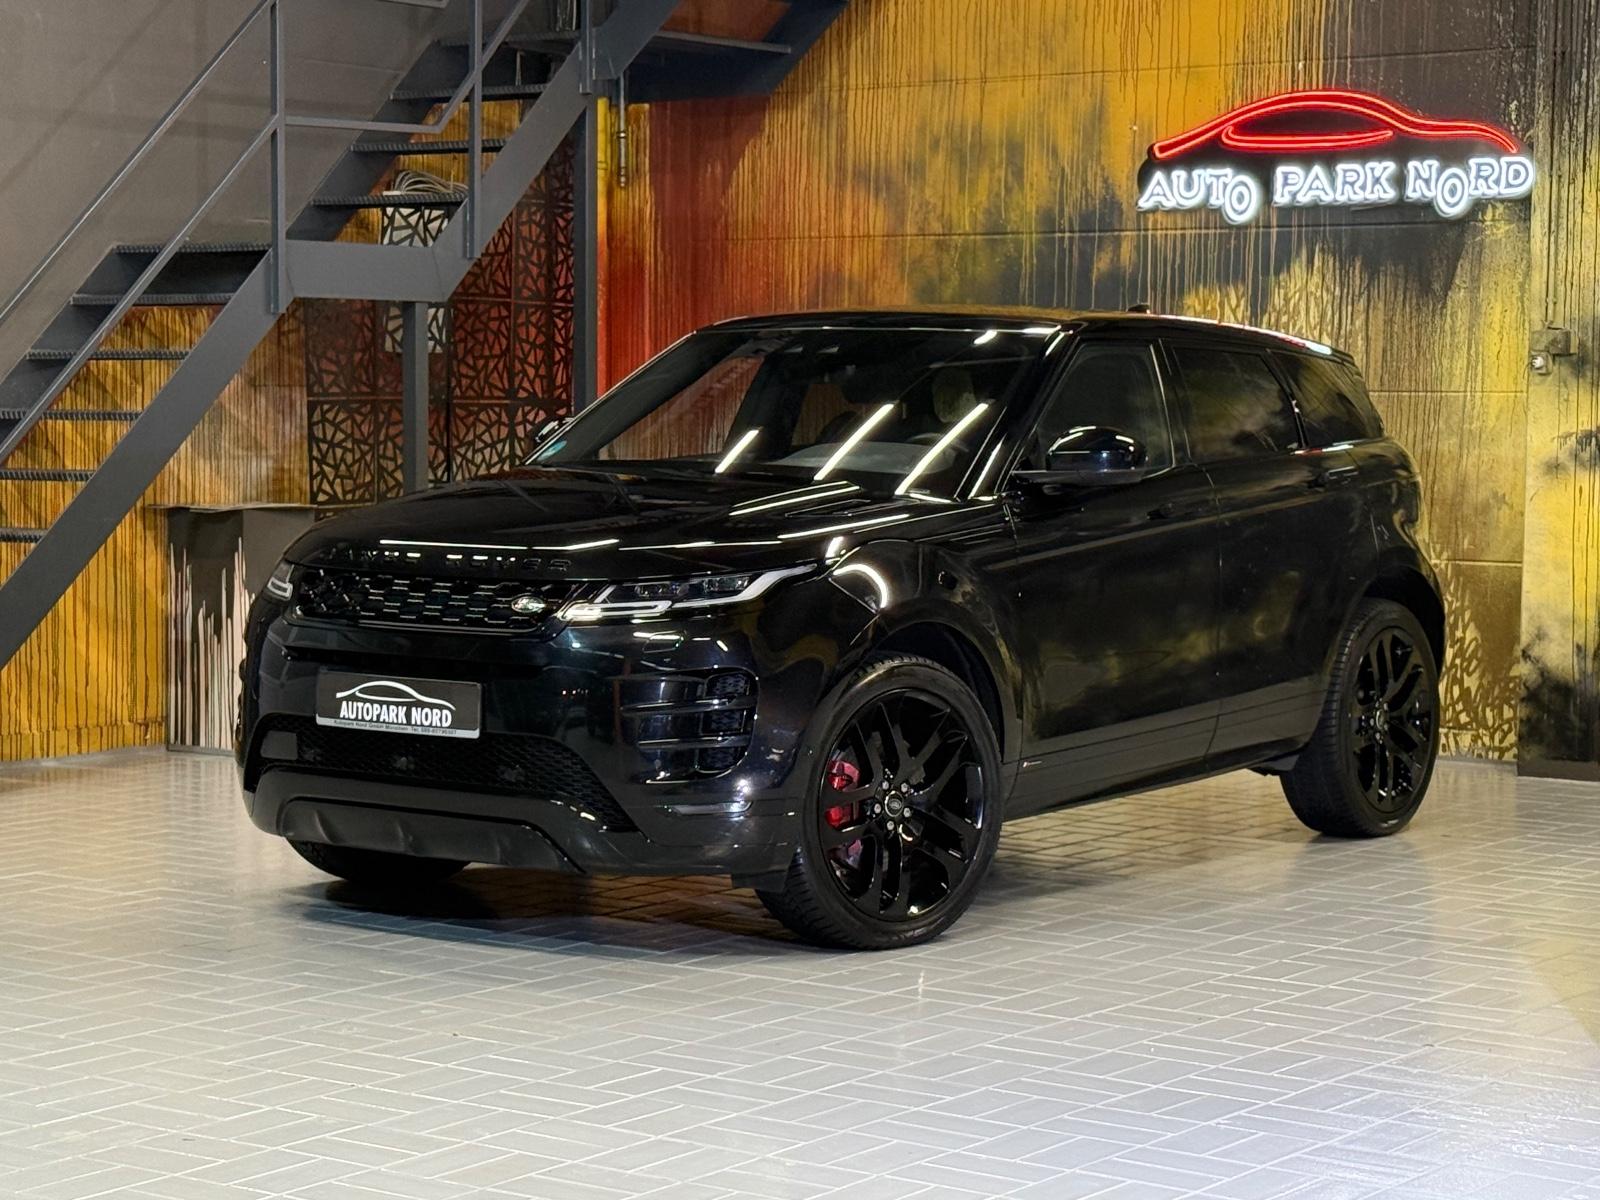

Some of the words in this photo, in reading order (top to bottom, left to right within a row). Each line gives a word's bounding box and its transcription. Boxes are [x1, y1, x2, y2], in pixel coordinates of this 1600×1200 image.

[1137, 169, 1257, 224] AUTO
[1272, 162, 1396, 206] PARK
[1405, 156, 1534, 217] NORD
[340, 700, 407, 724] AUTOPARK
[411, 706, 452, 728] NORD
